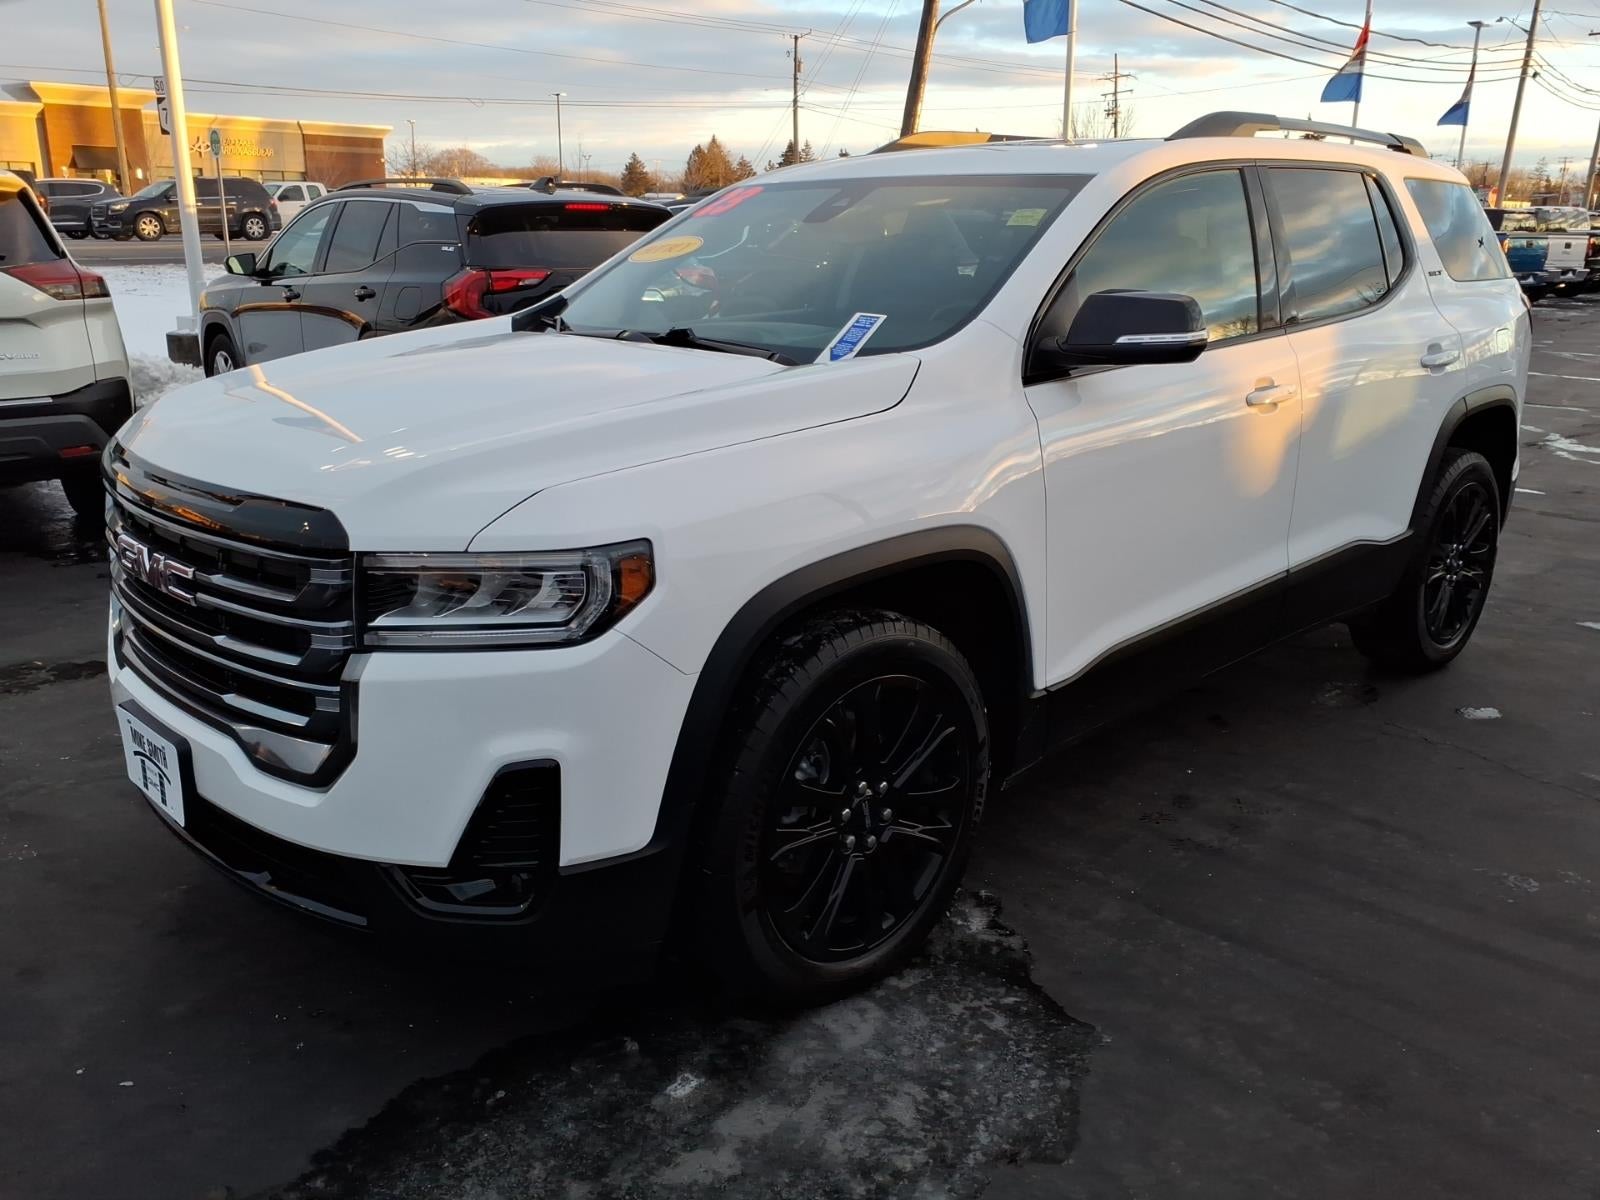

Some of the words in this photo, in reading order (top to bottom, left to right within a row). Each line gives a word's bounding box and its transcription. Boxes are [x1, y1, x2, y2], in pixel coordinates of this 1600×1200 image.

[117, 534, 197, 607] GMC
[130, 726, 147, 753] MIKE
[146, 738, 168, 770] SMITH
